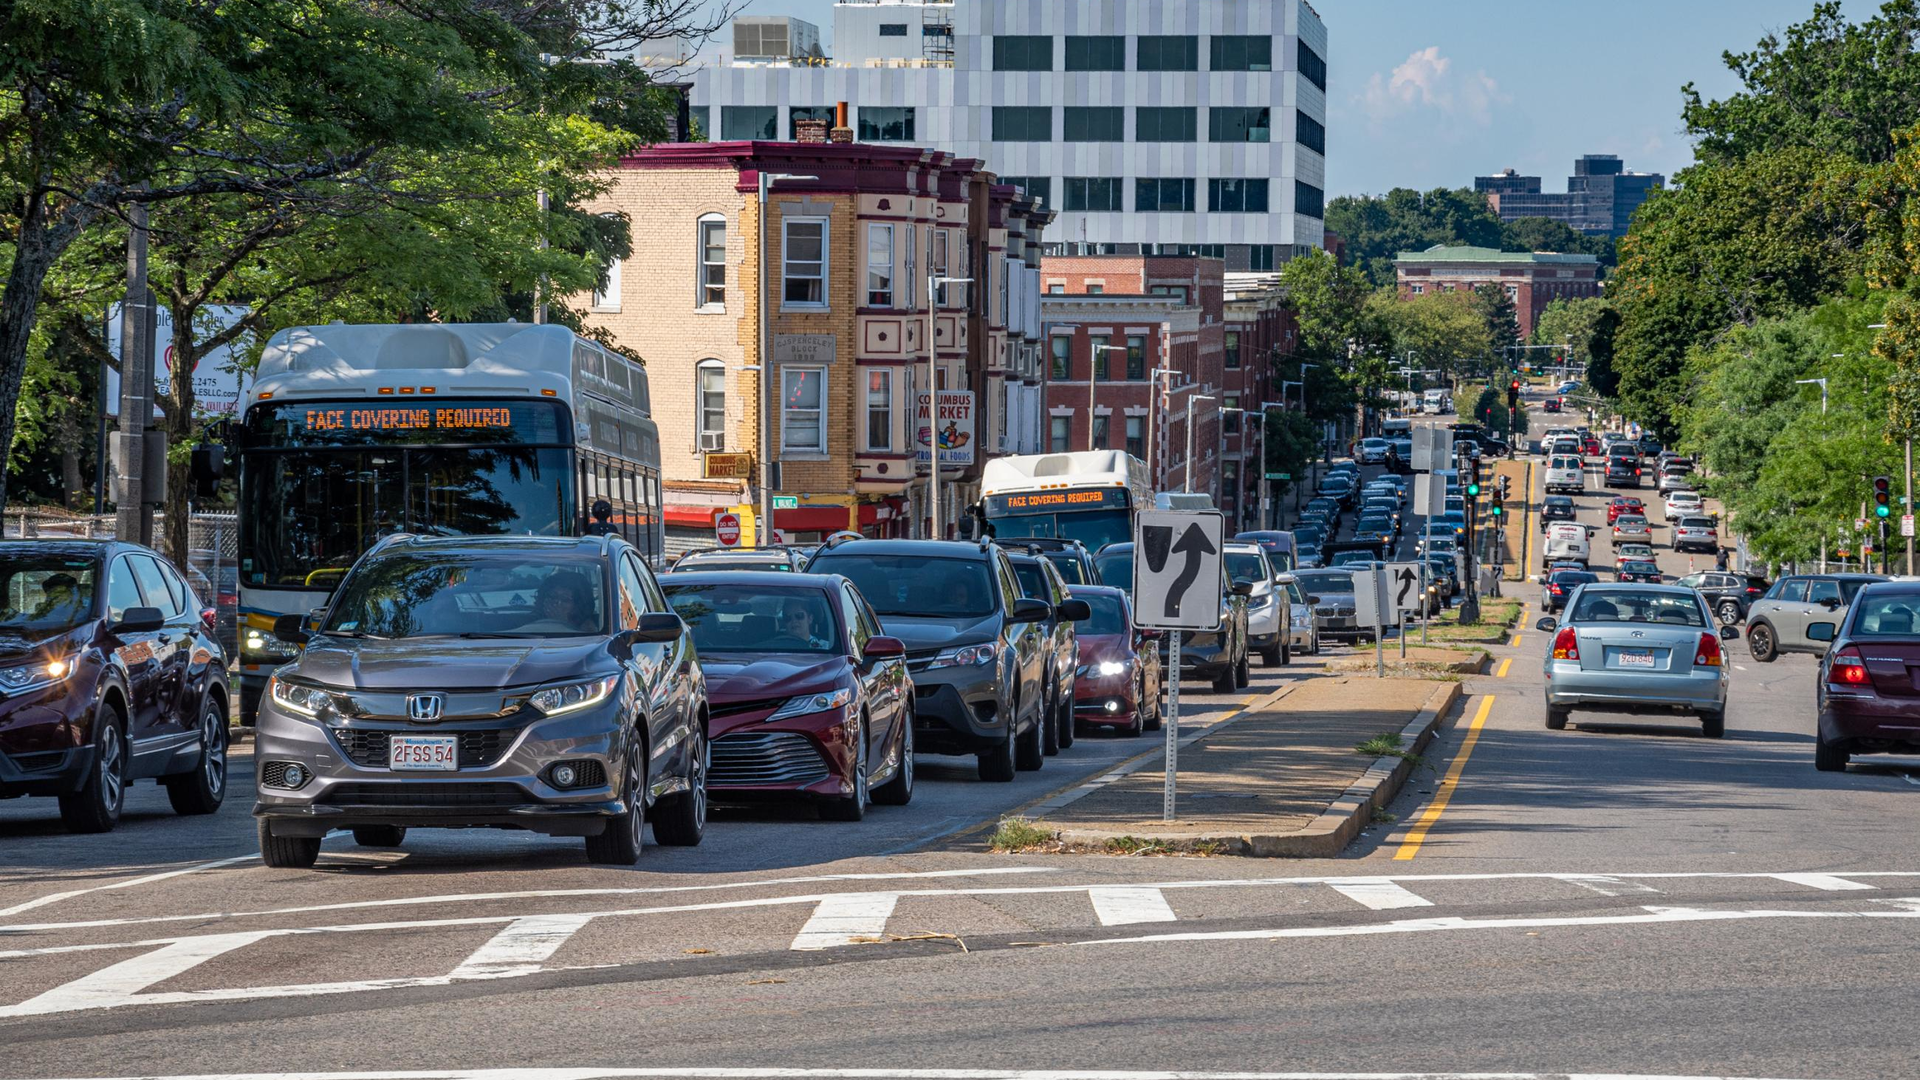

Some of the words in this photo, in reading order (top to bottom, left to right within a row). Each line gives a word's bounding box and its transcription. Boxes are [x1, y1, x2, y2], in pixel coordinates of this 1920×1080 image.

[918, 394, 971, 405] COUMBUS
[307, 410, 345, 429] FACE
[351, 408, 430, 429] COVERING
[436, 408, 510, 428] REQUIRED
[918, 405, 970, 420] MRKET
[917, 450, 947, 460] TROAL
[950, 451, 970, 460] FOODS
[709, 464, 736, 476] MARKET
[1008, 496, 1027, 507] FACE
[1028, 494, 1066, 506] COVERING
[1067, 491, 1103, 503] REQUIRED
[394, 745, 431, 762] 2FSS
[435, 745, 453, 762] 54
